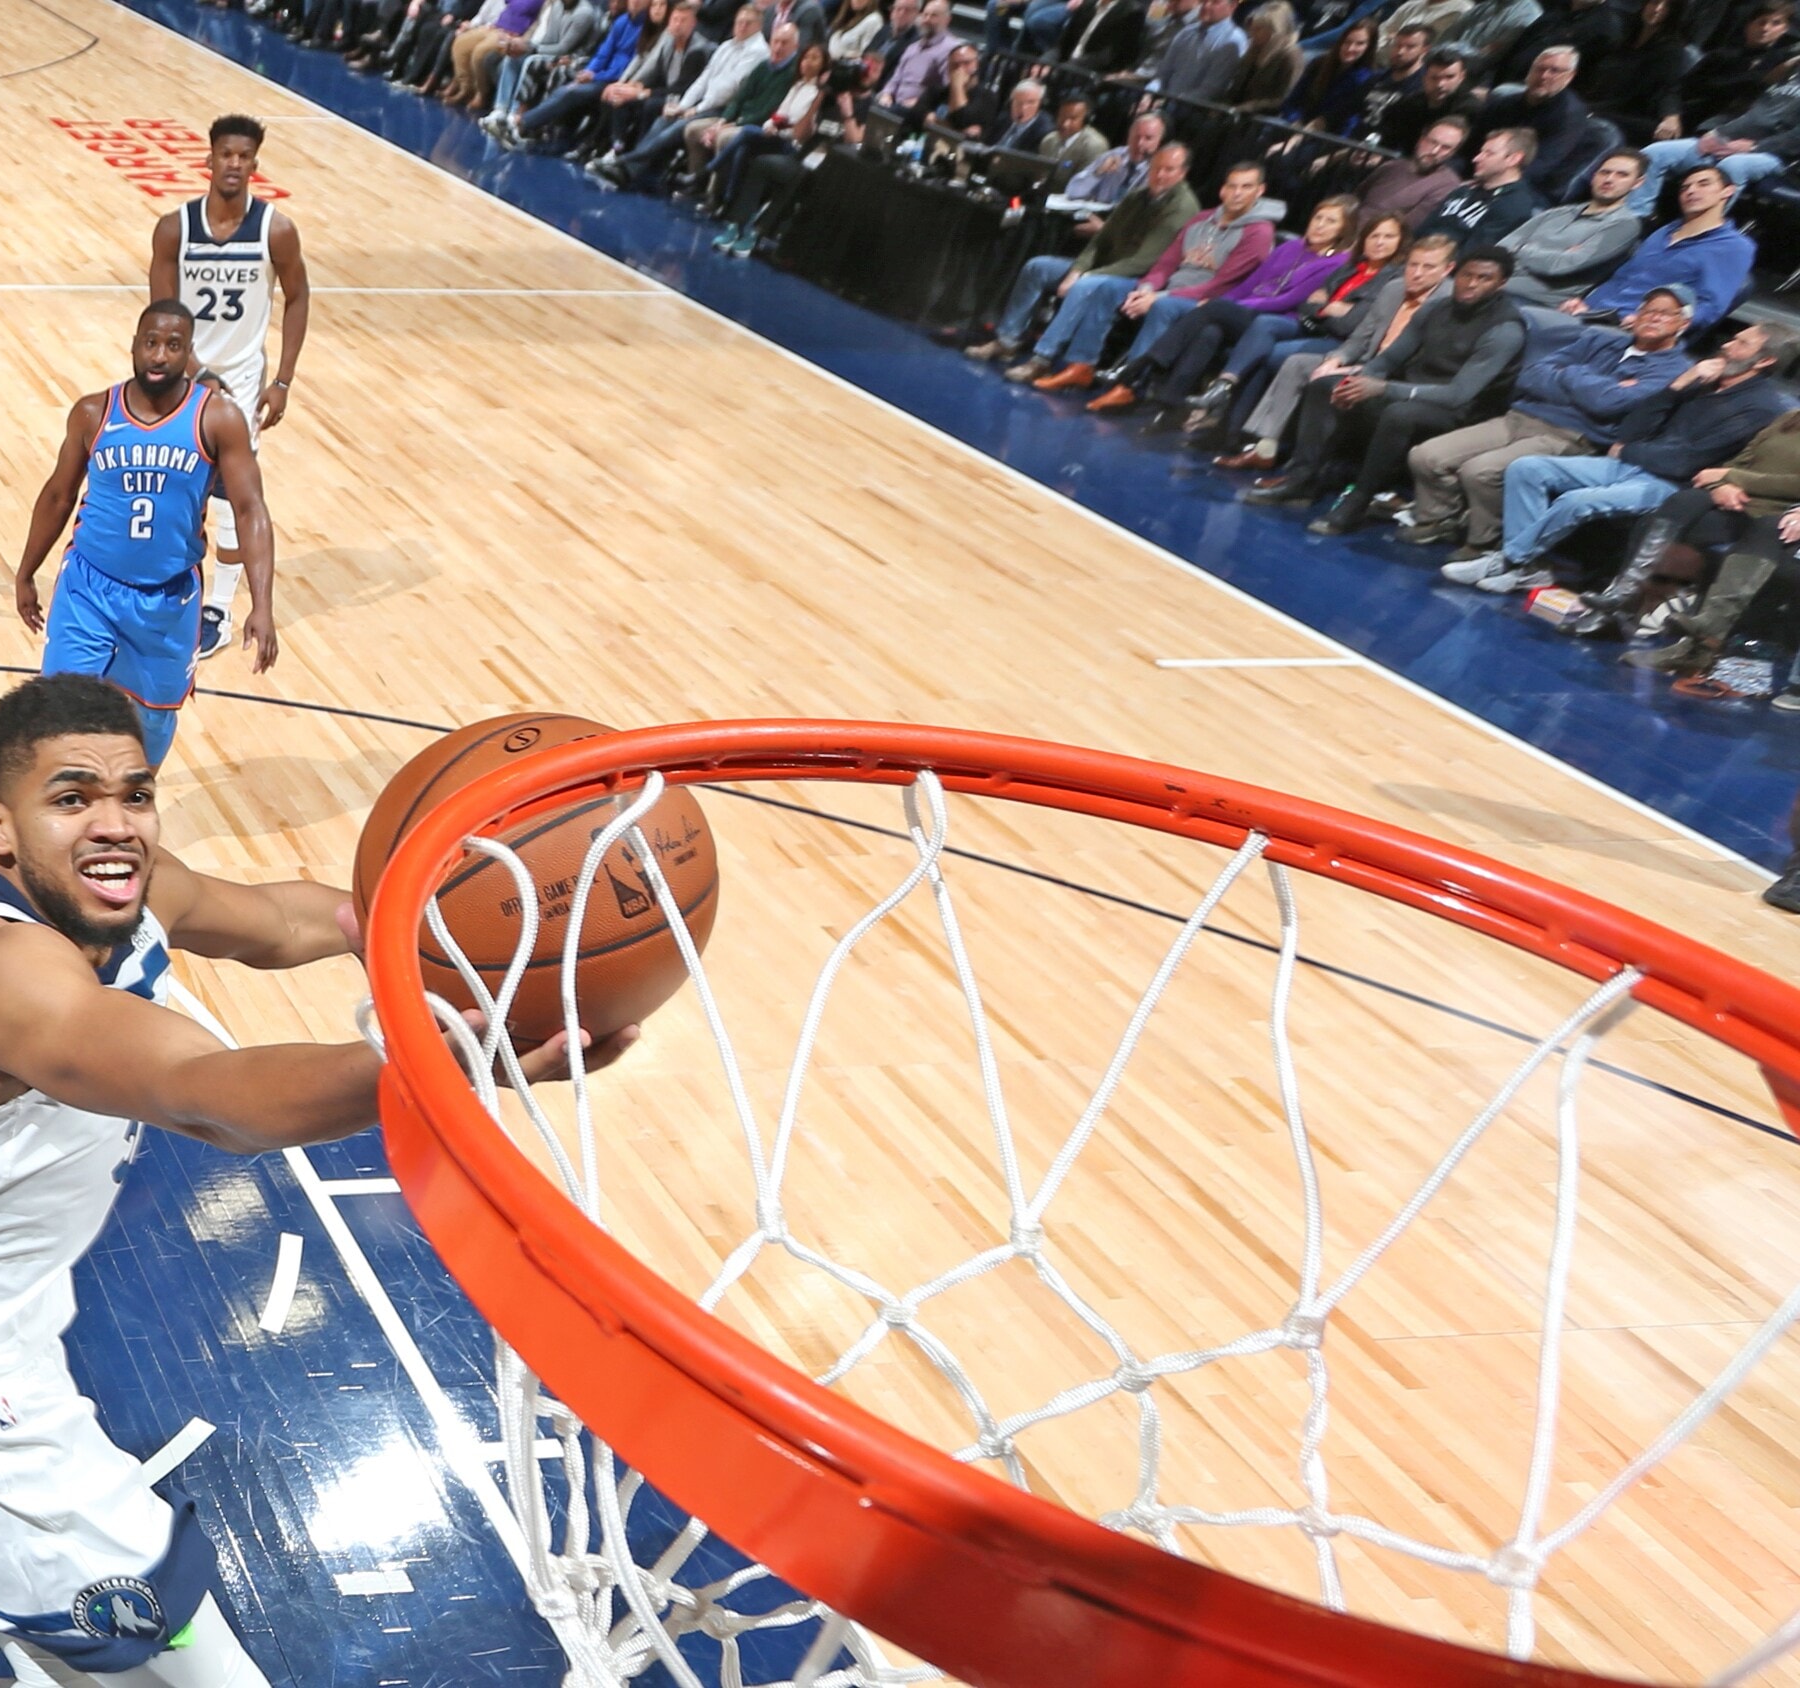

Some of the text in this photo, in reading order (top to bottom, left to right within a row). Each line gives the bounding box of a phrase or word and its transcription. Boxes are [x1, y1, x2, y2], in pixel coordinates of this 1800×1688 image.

[49, 117, 211, 197] TARGET
[124, 118, 293, 199] CTER
[184, 266, 260, 283] WOLVES
[195, 286, 246, 322] 23
[94, 444, 200, 474] OKLAHOMA
[123, 472, 167, 493] CITY
[130, 498, 154, 539] 2
[543, 877, 573, 901] GAME
